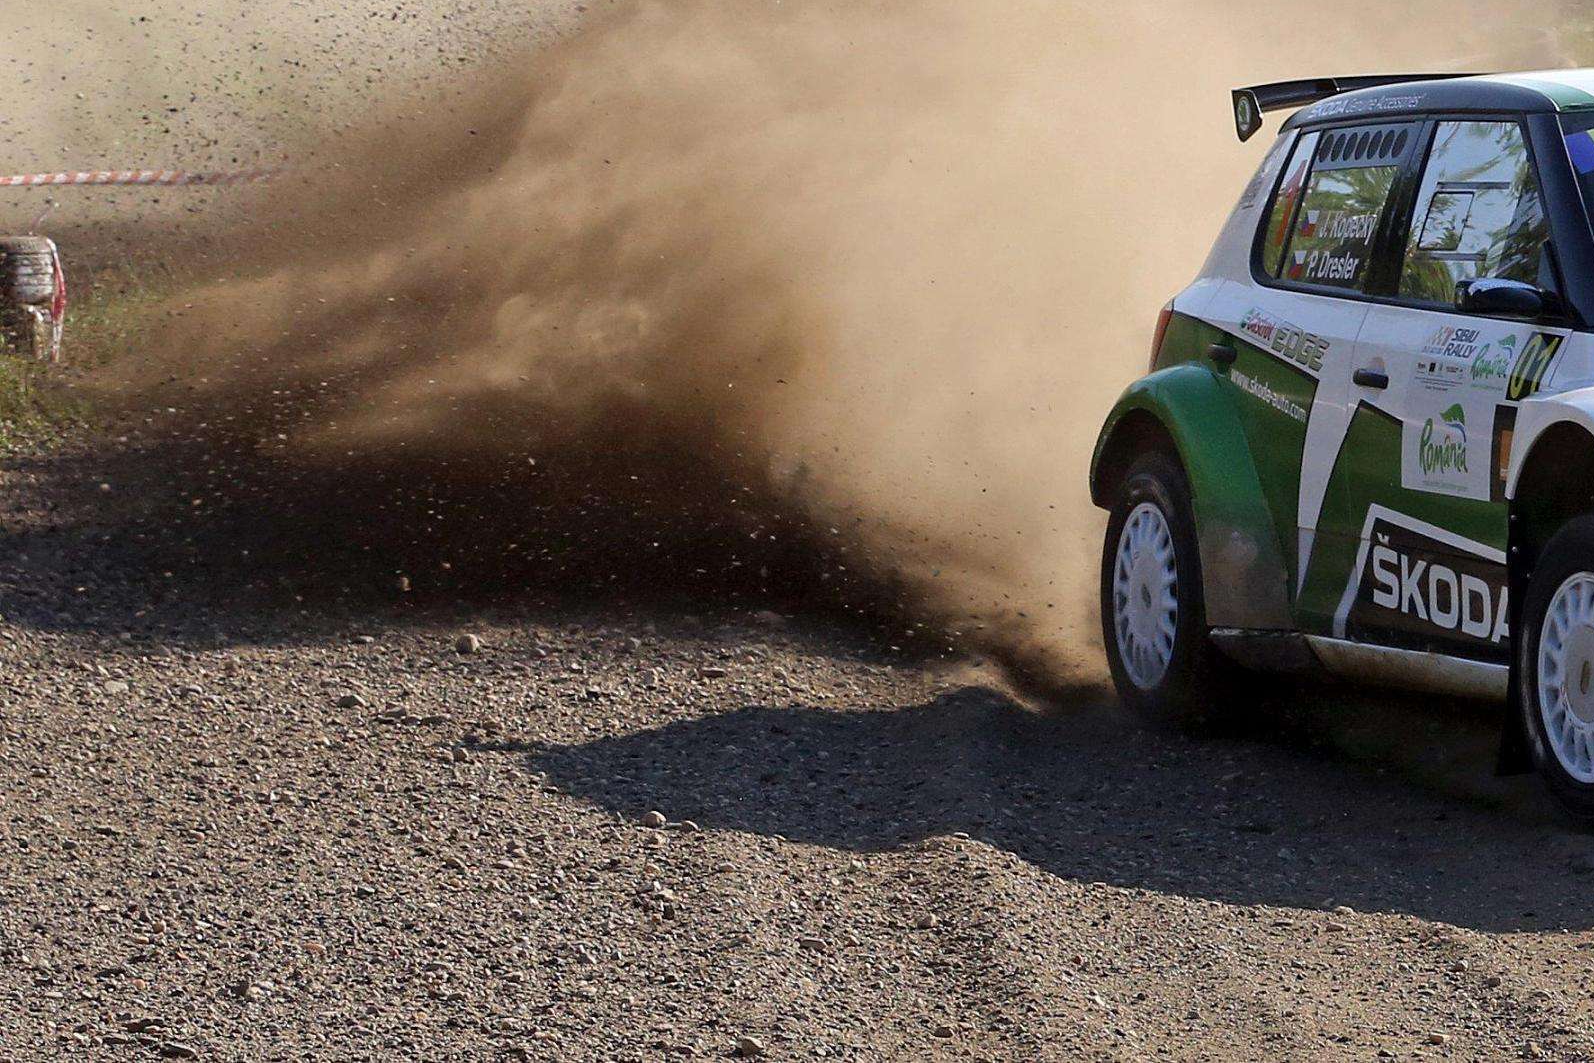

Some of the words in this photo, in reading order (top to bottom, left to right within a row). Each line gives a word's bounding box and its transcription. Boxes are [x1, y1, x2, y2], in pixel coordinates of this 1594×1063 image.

[1306, 250, 1318, 279] P.
[1318, 250, 1359, 280] Dresler
[1271, 322, 1330, 372] EDGE
[1443, 342, 1477, 358] RALLY
